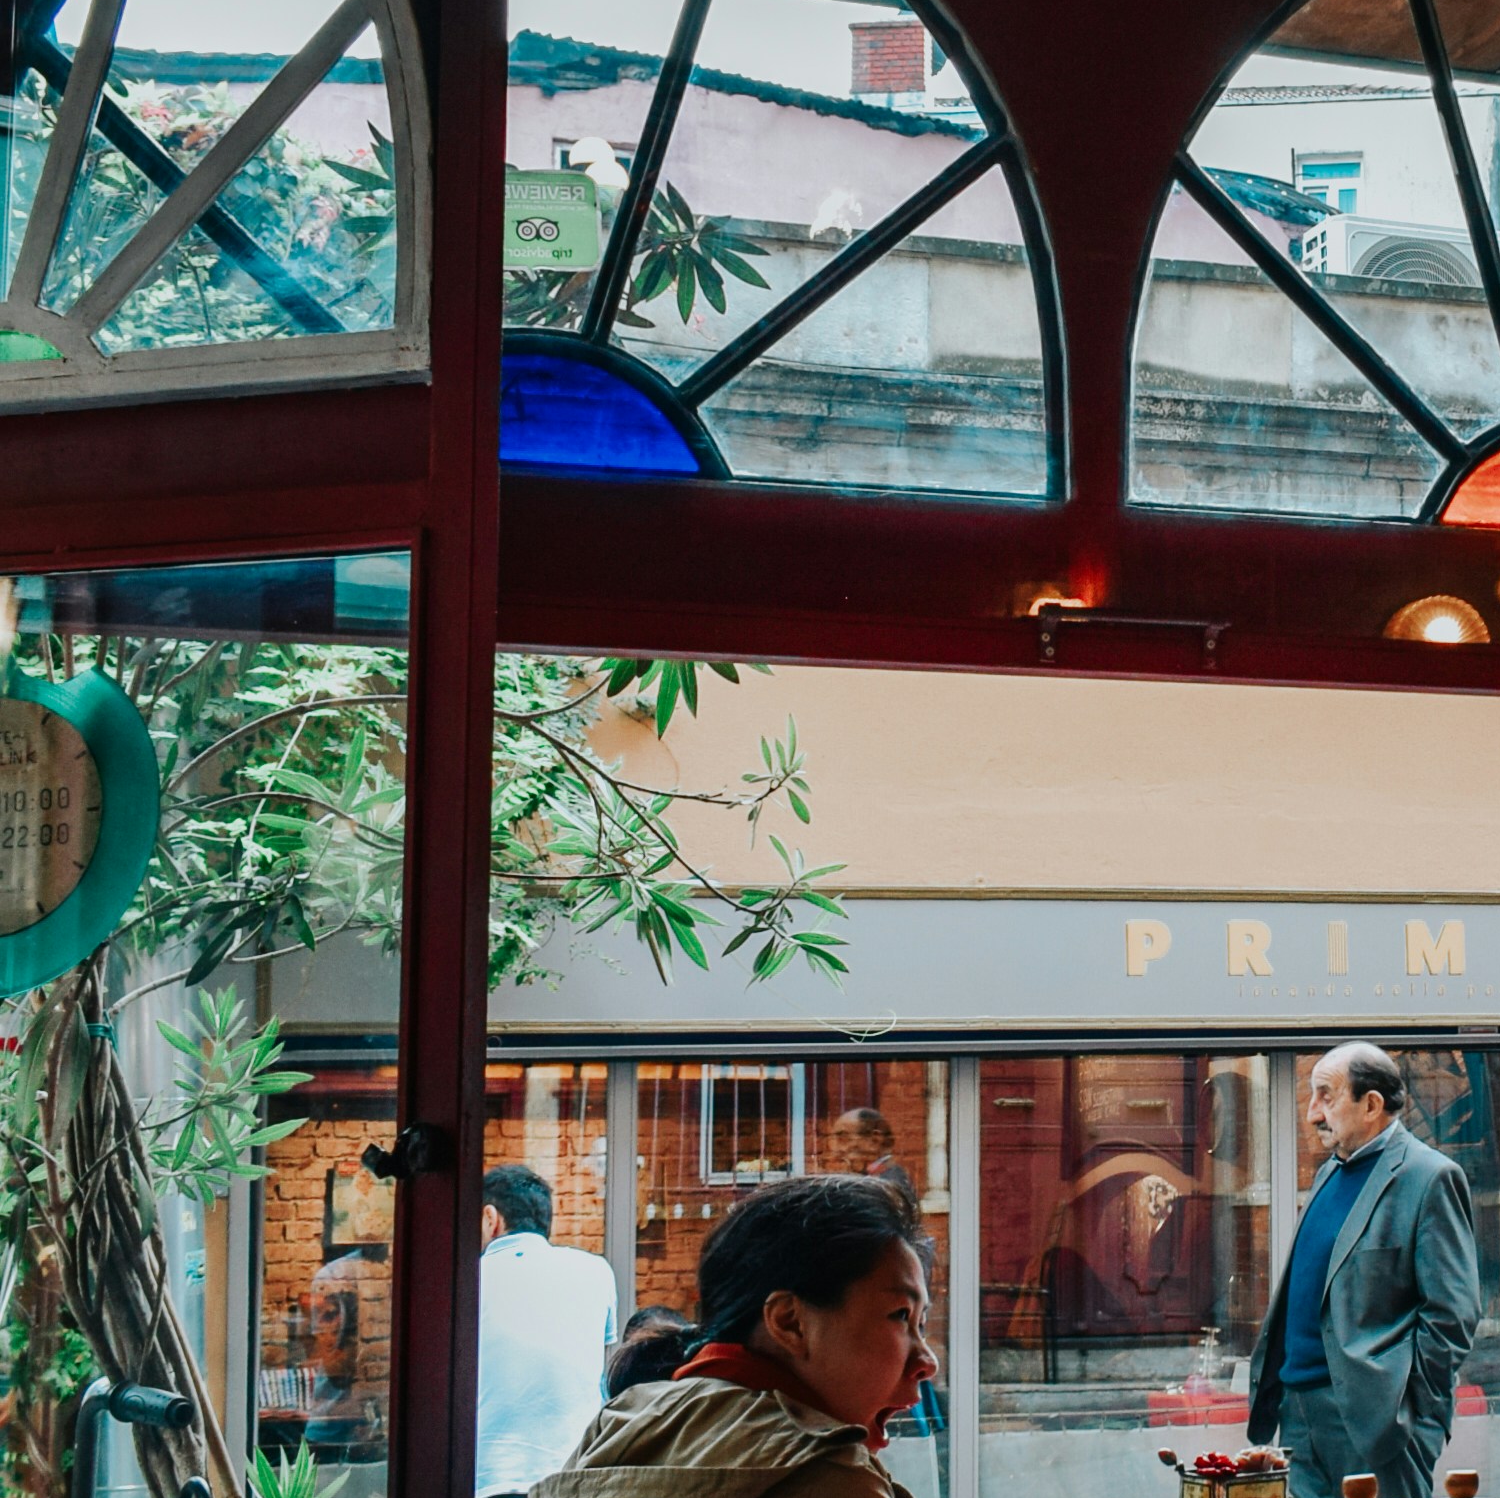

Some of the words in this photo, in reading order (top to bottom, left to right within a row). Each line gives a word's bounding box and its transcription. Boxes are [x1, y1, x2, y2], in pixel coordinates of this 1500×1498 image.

[3, 787, 70, 814] 10:00
[2, 823, 69, 848] 22:00
[1239, 982, 1352, 998] locanda
[1375, 982, 1445, 997] della
